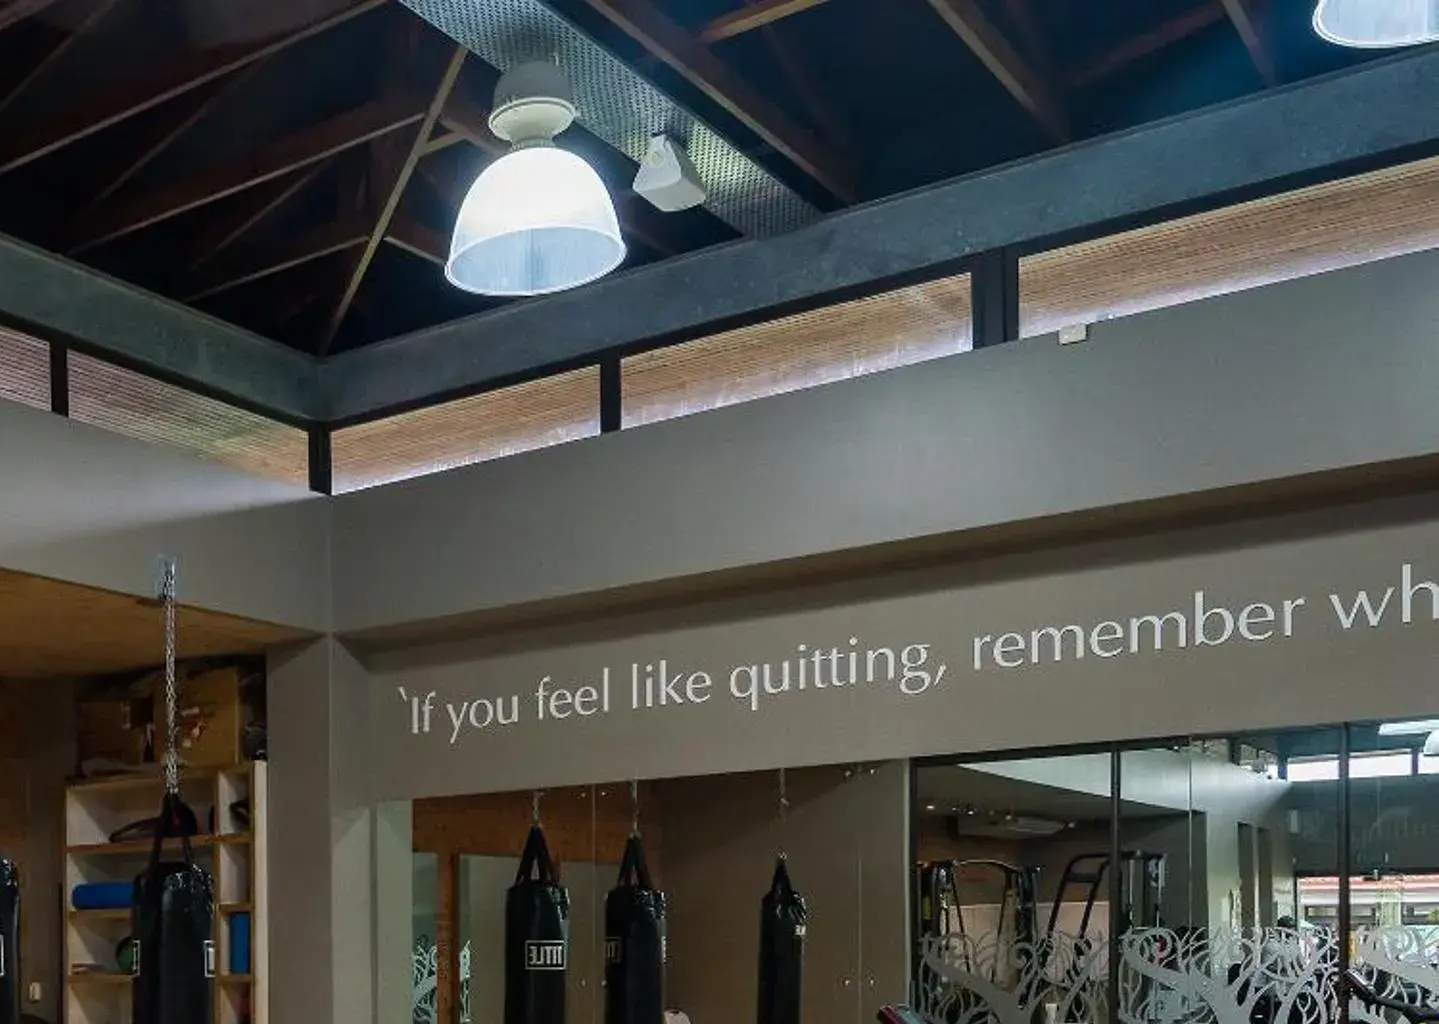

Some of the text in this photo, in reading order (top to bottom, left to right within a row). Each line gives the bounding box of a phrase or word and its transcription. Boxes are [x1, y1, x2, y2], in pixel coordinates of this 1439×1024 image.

[446, 694, 519, 744] you
[535, 666, 609, 721] feel
[632, 659, 712, 710] like
[729, 636, 947, 711] quitting,
[972, 590, 1307, 671] remember
[1328, 562, 1439, 630] wh
